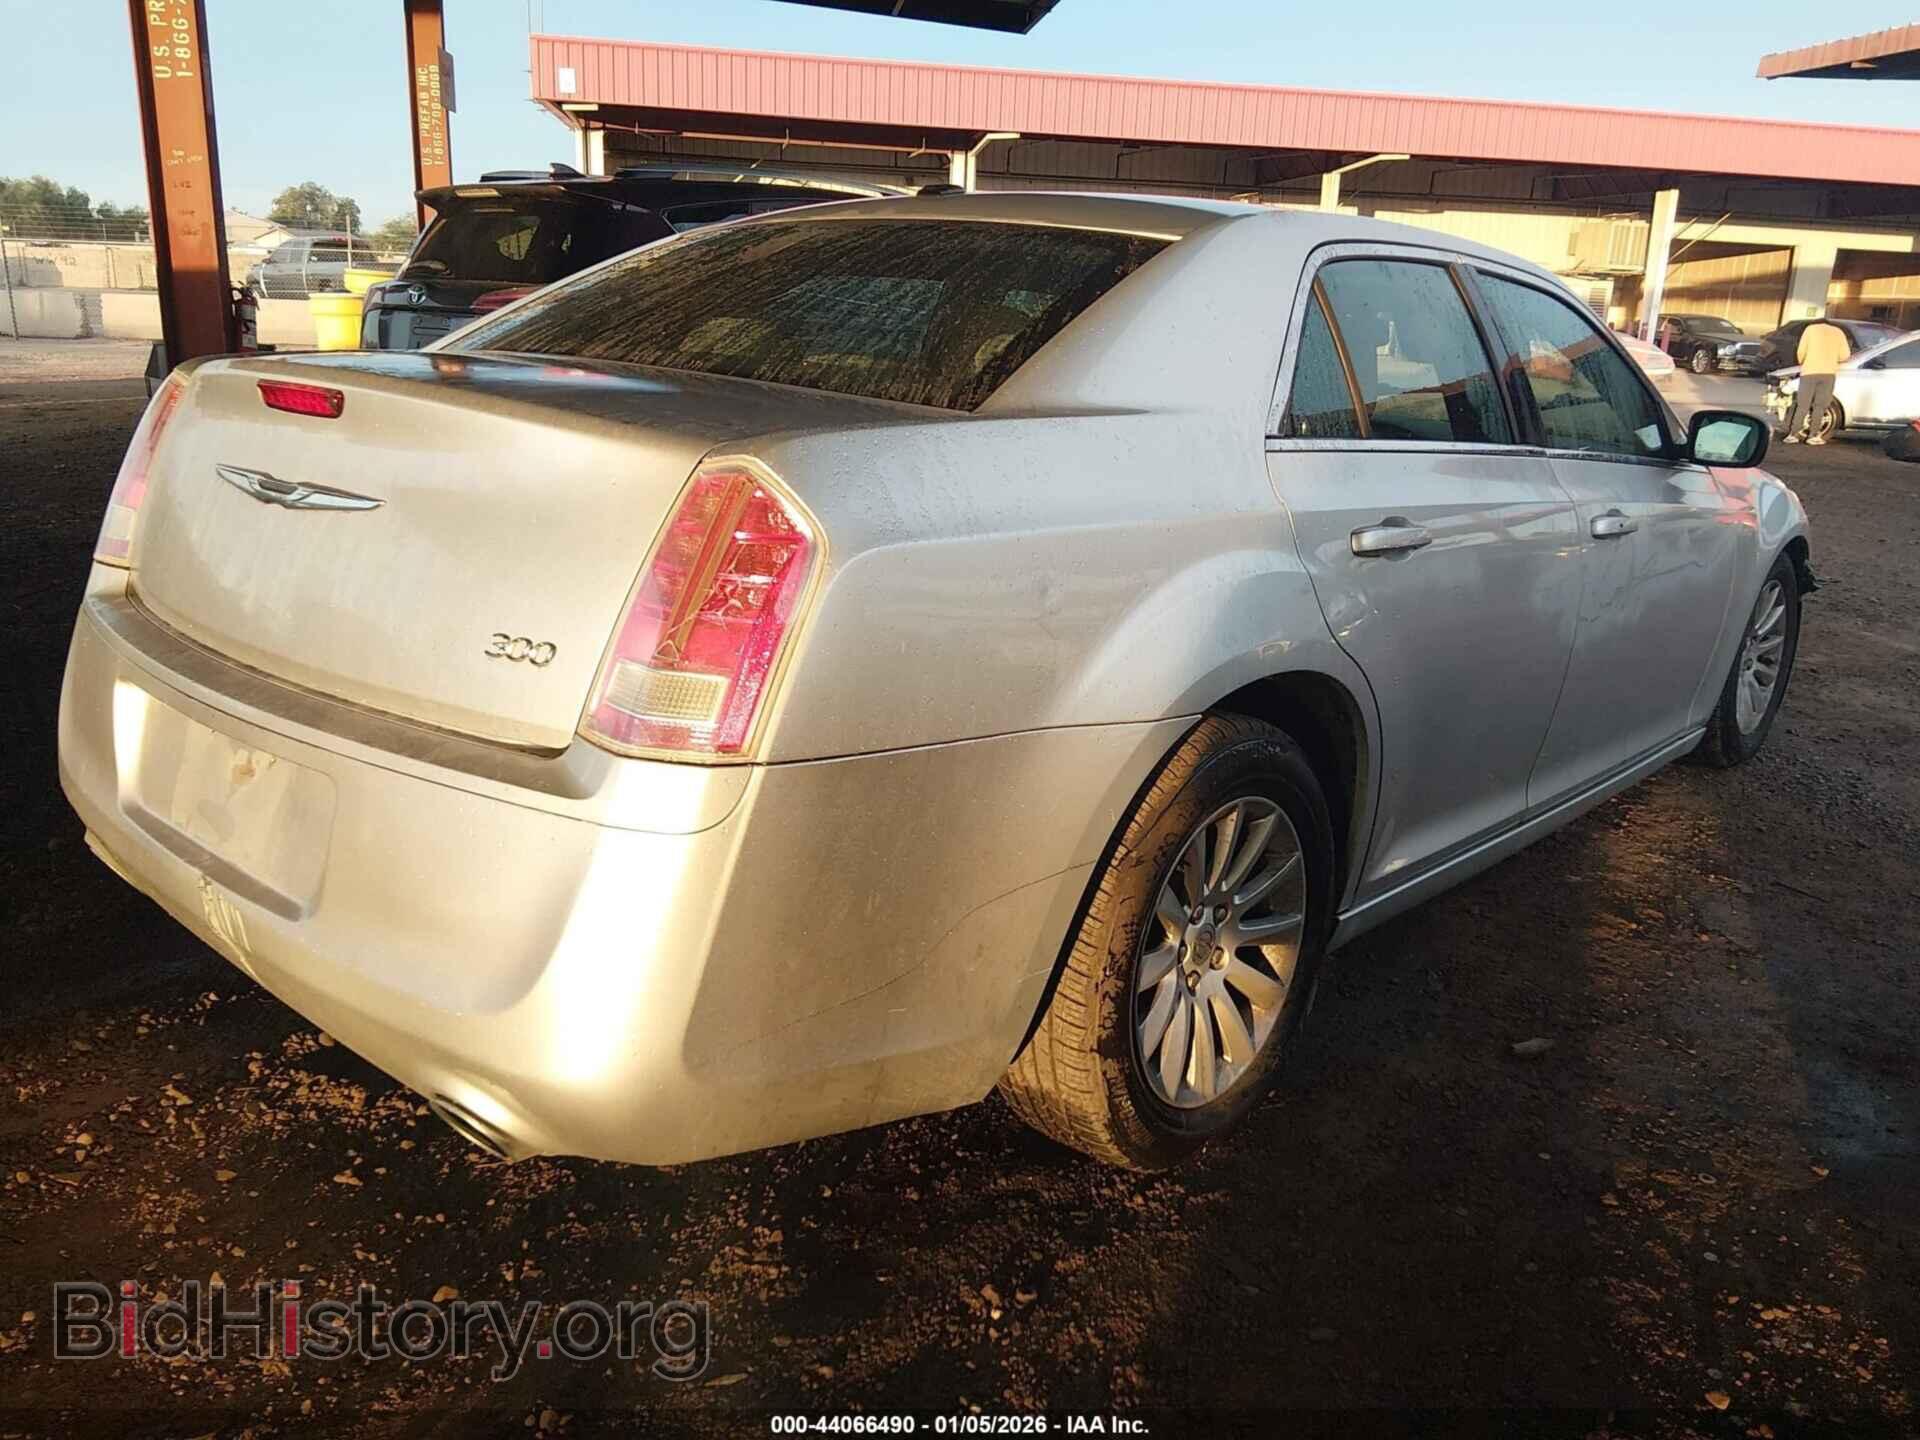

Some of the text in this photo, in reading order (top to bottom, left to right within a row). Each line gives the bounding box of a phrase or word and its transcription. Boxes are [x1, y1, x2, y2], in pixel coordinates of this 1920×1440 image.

[153, 39, 172, 78] U.S.
[419, 91, 432, 137] PREFAB
[422, 143, 433, 165] U.S.
[484, 632, 557, 668] 300
